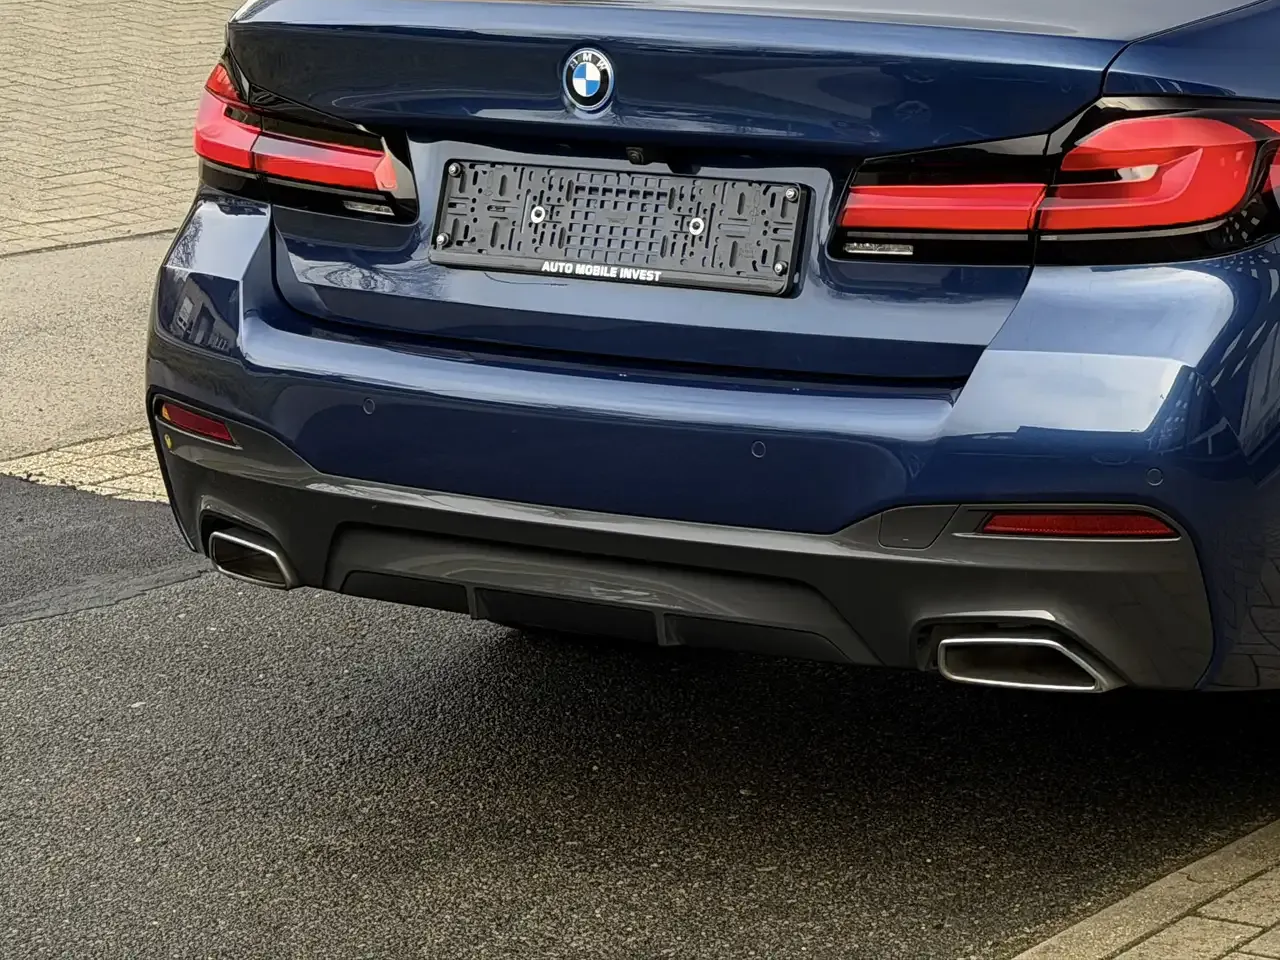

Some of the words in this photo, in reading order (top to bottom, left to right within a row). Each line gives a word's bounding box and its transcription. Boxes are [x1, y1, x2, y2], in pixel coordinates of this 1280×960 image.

[541, 260, 574, 274] AUTO
[575, 263, 618, 278] MOBILE
[619, 267, 662, 282] INVEST
